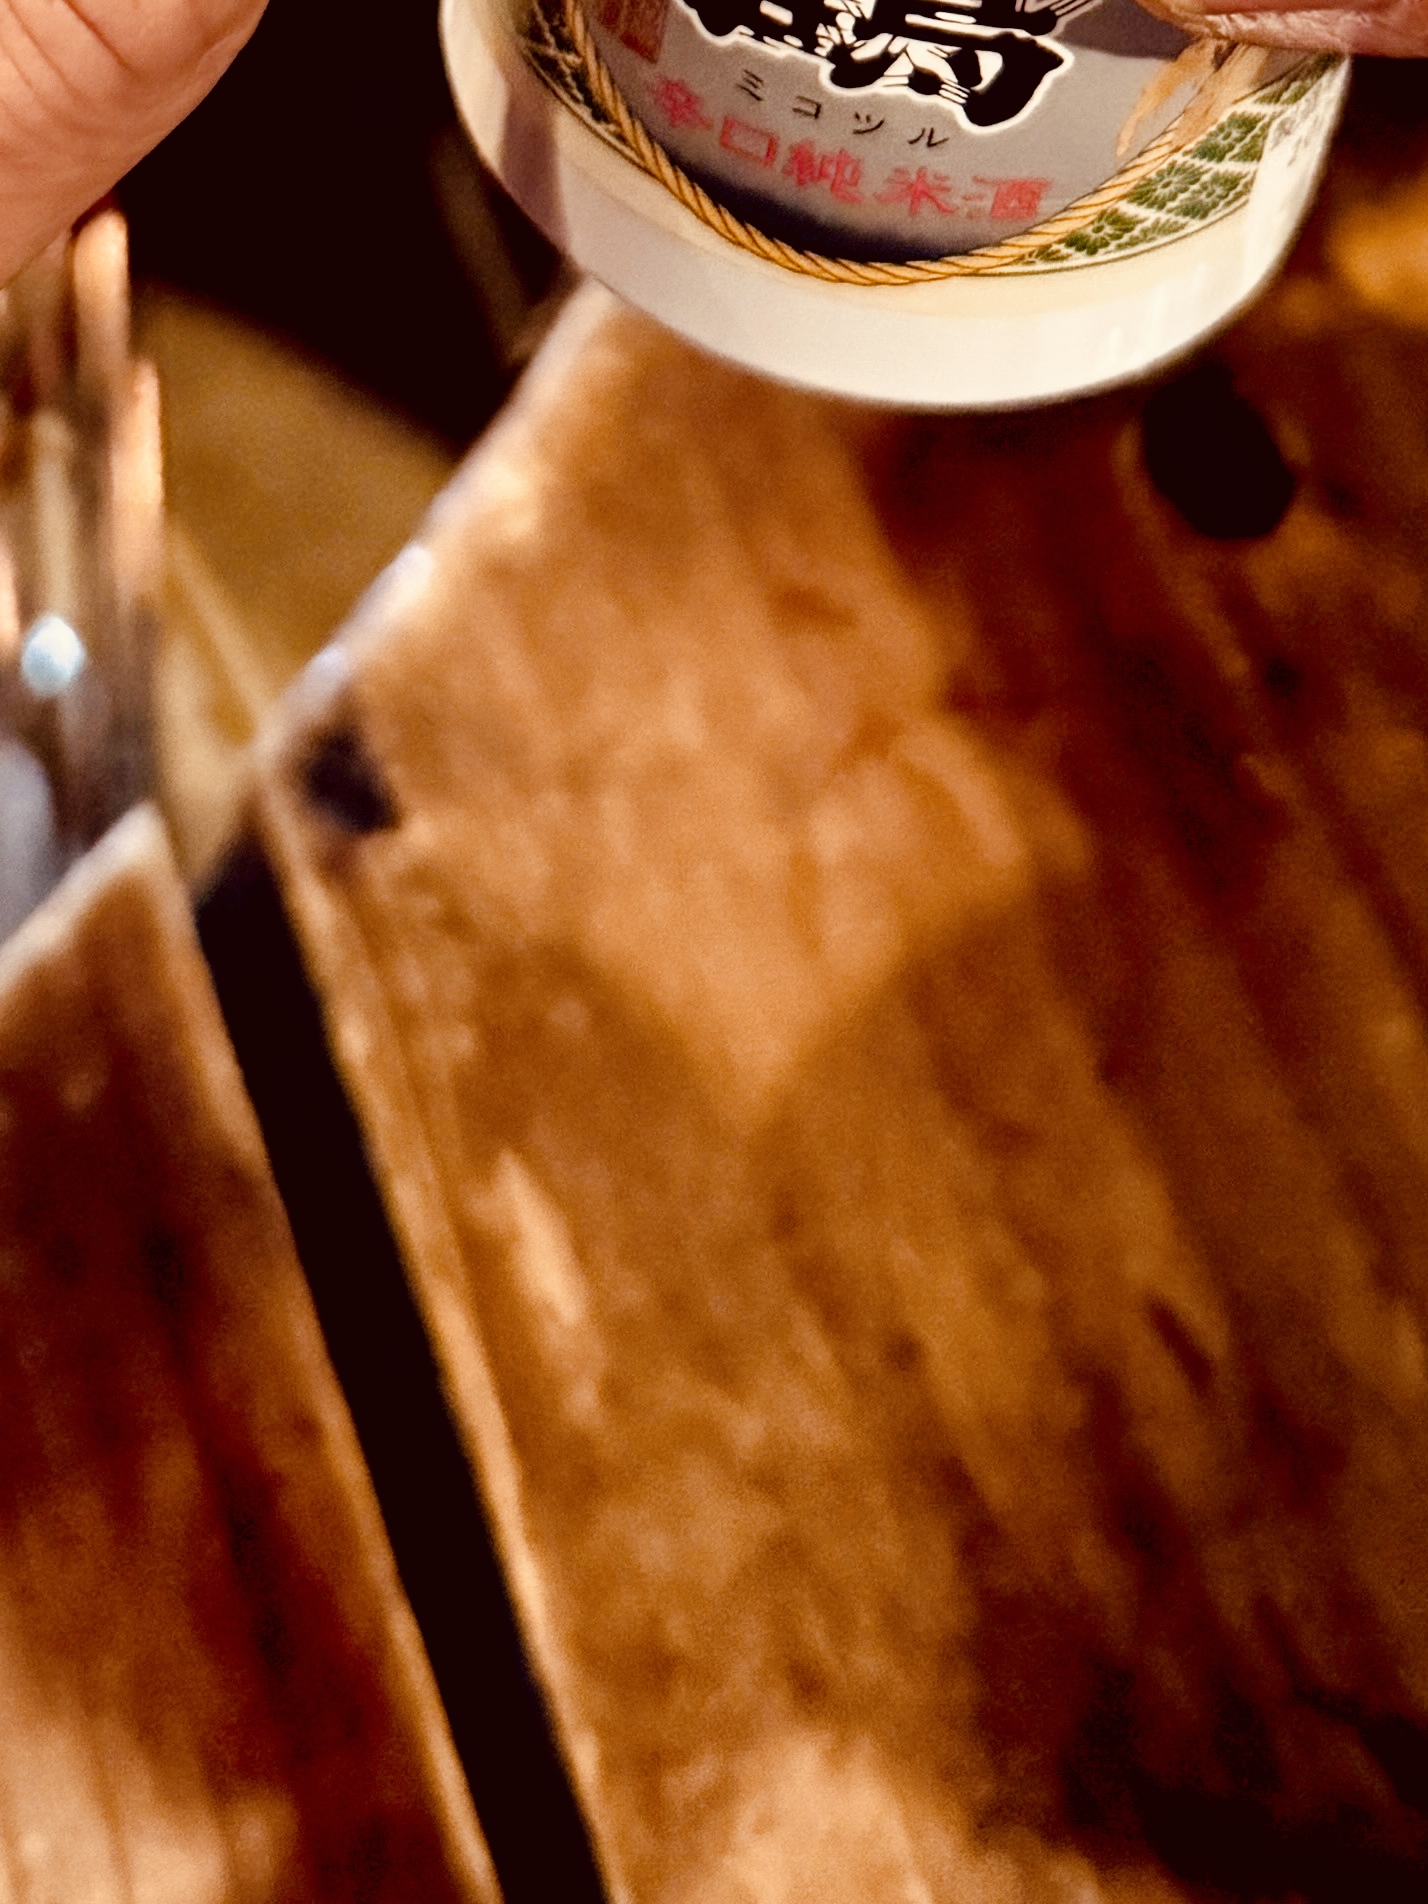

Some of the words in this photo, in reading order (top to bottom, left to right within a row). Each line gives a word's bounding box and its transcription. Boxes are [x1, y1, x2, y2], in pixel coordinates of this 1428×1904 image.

[652, 77, 1052, 222] 辛口純米酒
[737, 69, 950, 148] ミコツル
